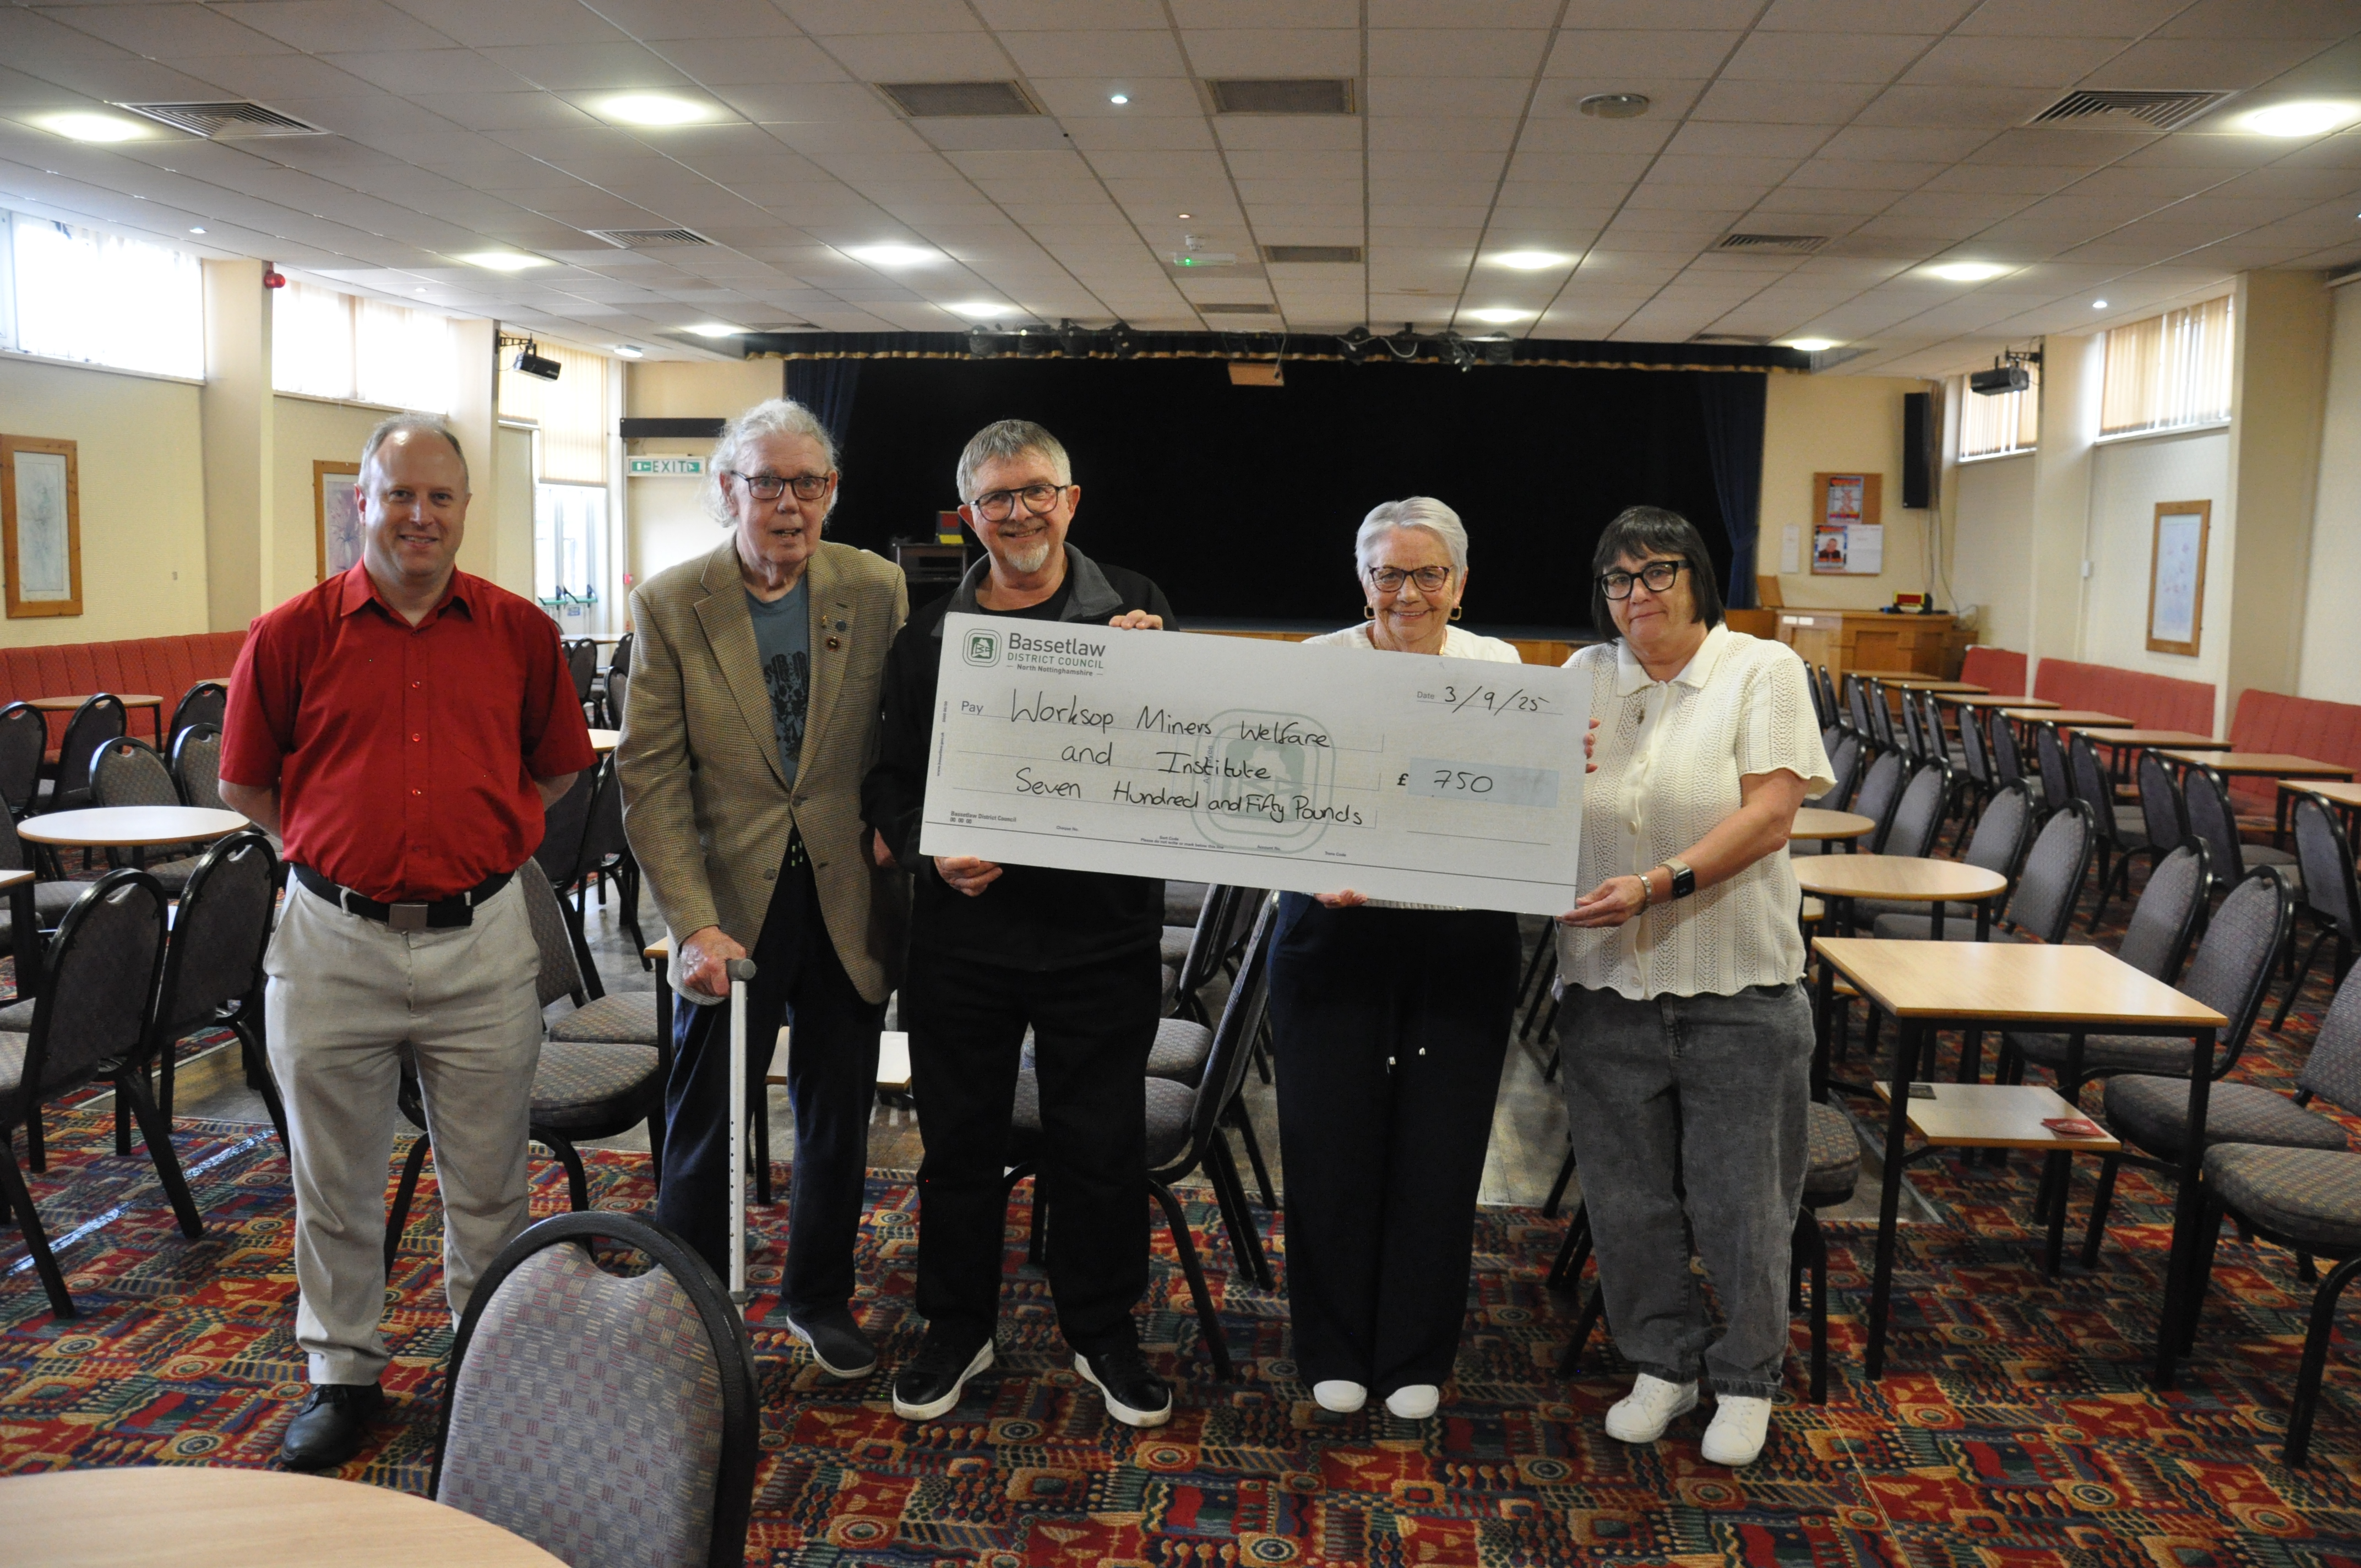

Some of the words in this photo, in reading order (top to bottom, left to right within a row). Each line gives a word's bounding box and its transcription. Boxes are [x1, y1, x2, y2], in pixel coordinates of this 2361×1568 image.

[653, 461, 686, 472] EXIT
[1009, 633, 1106, 657] Bassetlaw
[1007, 652, 1054, 664] DISTRICT
[1058, 657, 1104, 668] COUNCIL
[1038, 666, 1093, 676] Nottinghamshire
[1417, 691, 1435, 700] Date
[961, 701, 983, 715] Pay
[1011, 689, 1113, 734] Worksop
[1136, 706, 1212, 734] Miners
[1241, 721, 1330, 747] Welfare
[1062, 742, 1112, 766] and
[1156, 752, 1270, 779] Institute
[1397, 773, 1409, 786] £
[1434, 770, 1493, 793] 750
[1016, 767, 1081, 798] Seven
[1113, 781, 1198, 808] Hundred
[1208, 797, 1241, 812] and
[1246, 793, 1284, 823] Fifty
[1292, 795, 1362, 824] Pounds
